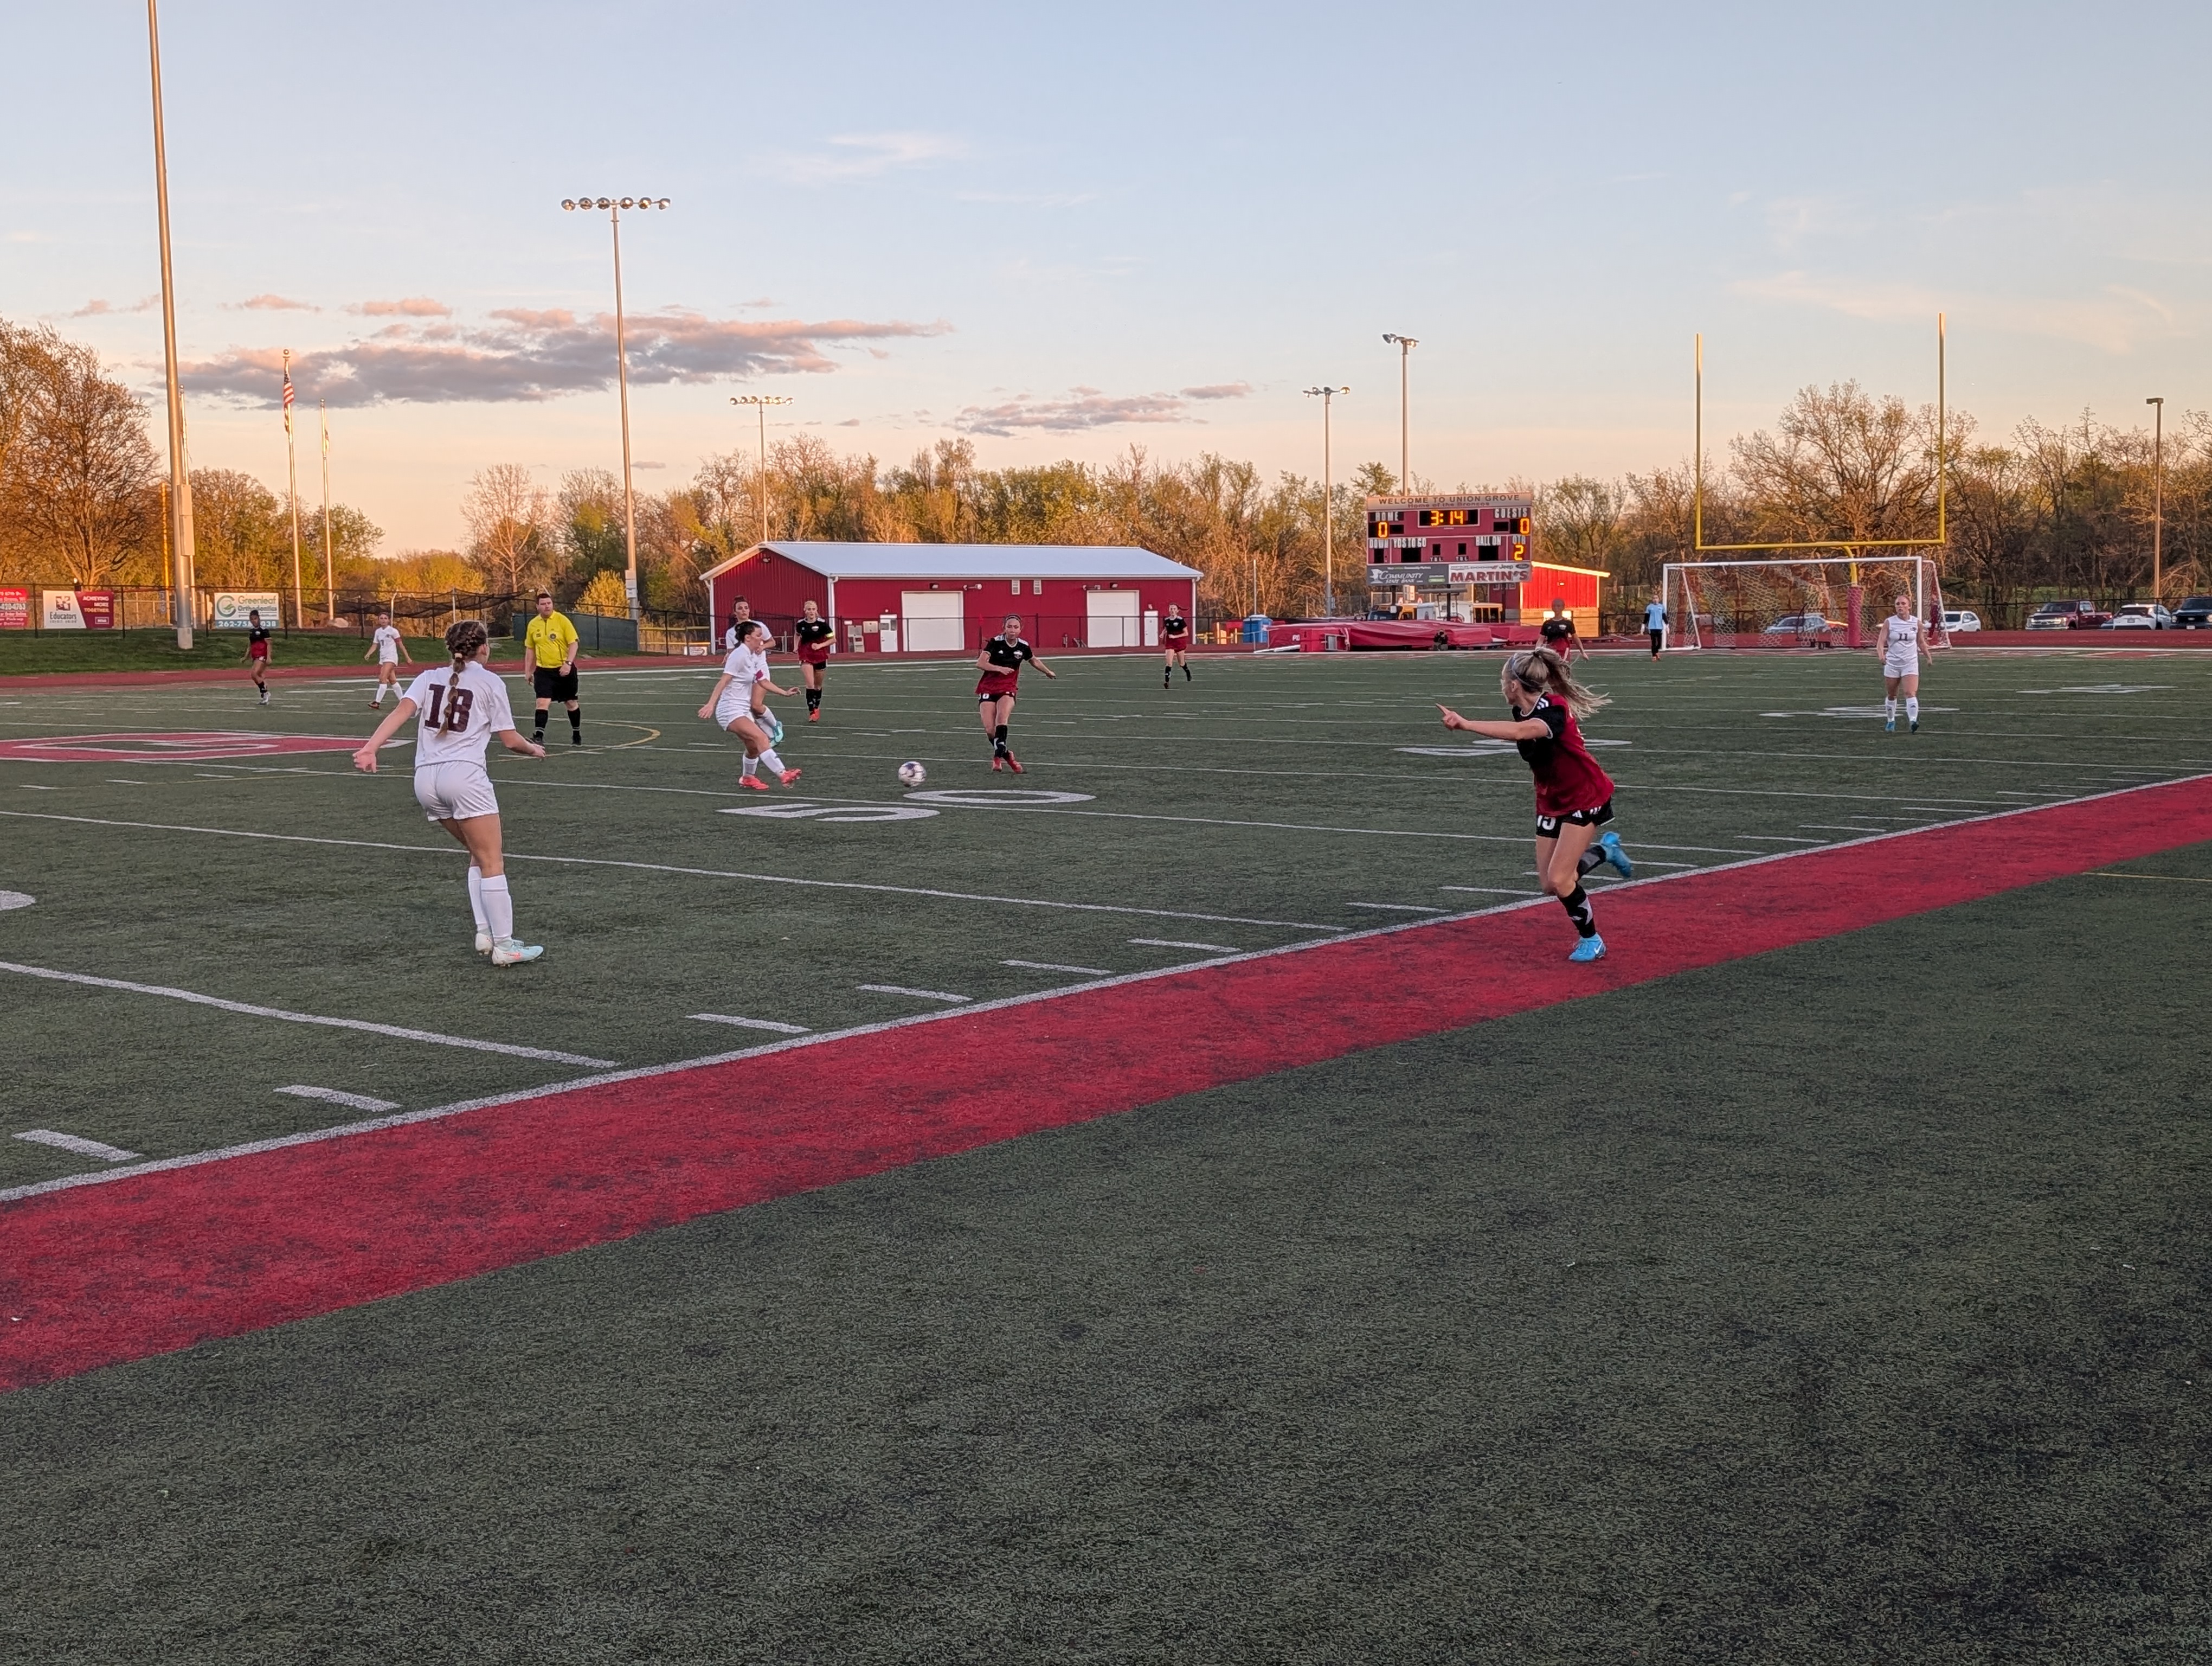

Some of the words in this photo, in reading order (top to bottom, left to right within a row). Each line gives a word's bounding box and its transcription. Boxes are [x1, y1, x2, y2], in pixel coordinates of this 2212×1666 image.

[1375, 511, 1399, 521] HOME
[1431, 510, 1463, 526] 3:14
[1495, 508, 1527, 518] GUESTS
[1378, 522, 1388, 537] 0
[1520, 518, 1529, 534] 0
[1369, 539, 1388, 548] DOWN
[1476, 536, 1491, 546] BALL
[1492, 536, 1501, 546] ON
[1514, 545, 1524, 561] 2
[1450, 571, 1528, 582] MARTIN'S
[238, 595, 276, 605] Greenleaf
[1898, 633, 1908, 641] 11
[425, 683, 474, 733] 18
